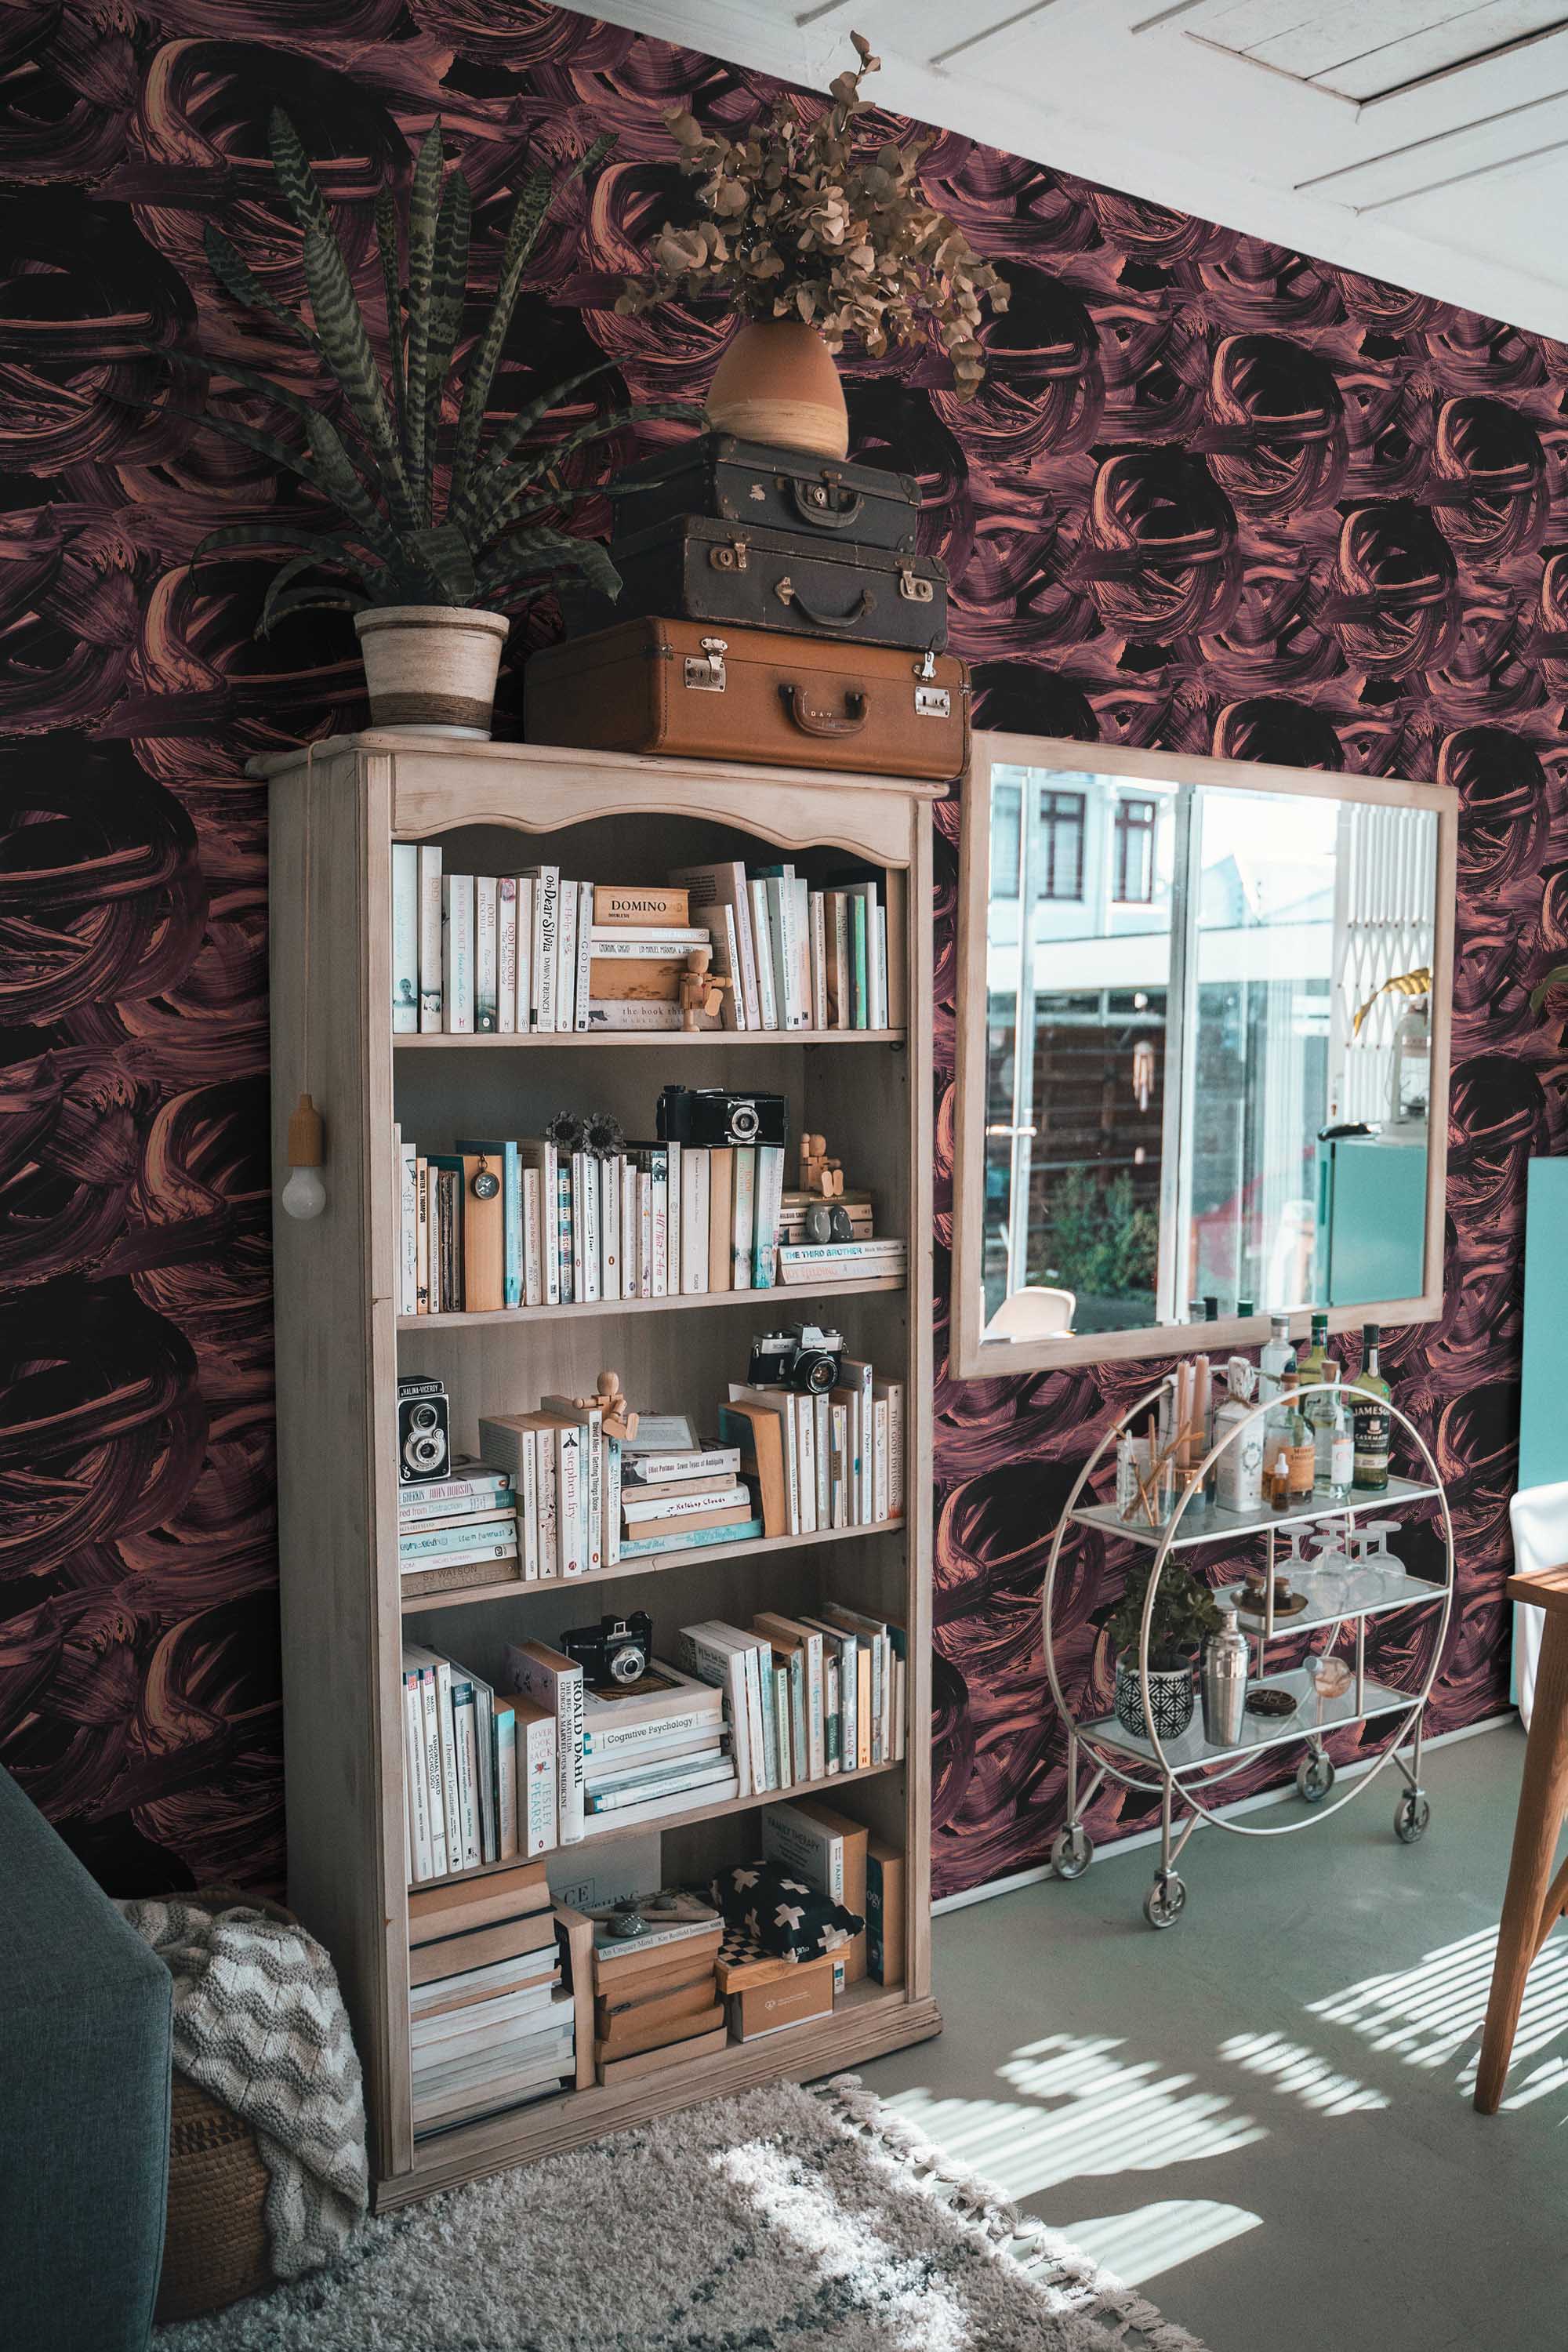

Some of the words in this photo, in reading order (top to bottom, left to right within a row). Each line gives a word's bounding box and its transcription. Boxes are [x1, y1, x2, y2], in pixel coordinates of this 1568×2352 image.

[546, 875, 555, 889] Oh
[543, 889, 557, 919] Dear
[612, 900, 666, 913] DOMINO
[563, 908, 572, 930] Help
[543, 919, 555, 952] Silvia
[641, 1007, 663, 1015] book
[668, 1007, 684, 1015] thi
[656, 1229, 665, 1248] That
[826, 1248, 862, 1257] BROTHER
[657, 1259, 665, 1276] Am
[402, 1385, 438, 1396] HALINA-VICEROY
[1352, 1406, 1390, 1417] JAMESO
[564, 1450, 577, 1497] stephen
[402, 1491, 425, 1504] GHERKIN
[412, 1507, 426, 1515] from
[428, 1503, 463, 1513] Distraction
[564, 1502, 577, 1519] fry
[437, 1565, 477, 1578] WATSON
[573, 1679, 583, 1736] ROALD
[608, 1727, 647, 1744] Cognitive
[648, 1717, 693, 1735] Psychology
[444, 1743, 454, 1769] Themes
[844, 1740, 854, 1756] Gift
[574, 1742, 583, 1788] DAHL
[447, 1780, 456, 1816] Variations
[543, 1781, 552, 1825] LESLEY
[531, 1781, 542, 1835] PEARSE
[564, 1885, 590, 1905] CE
